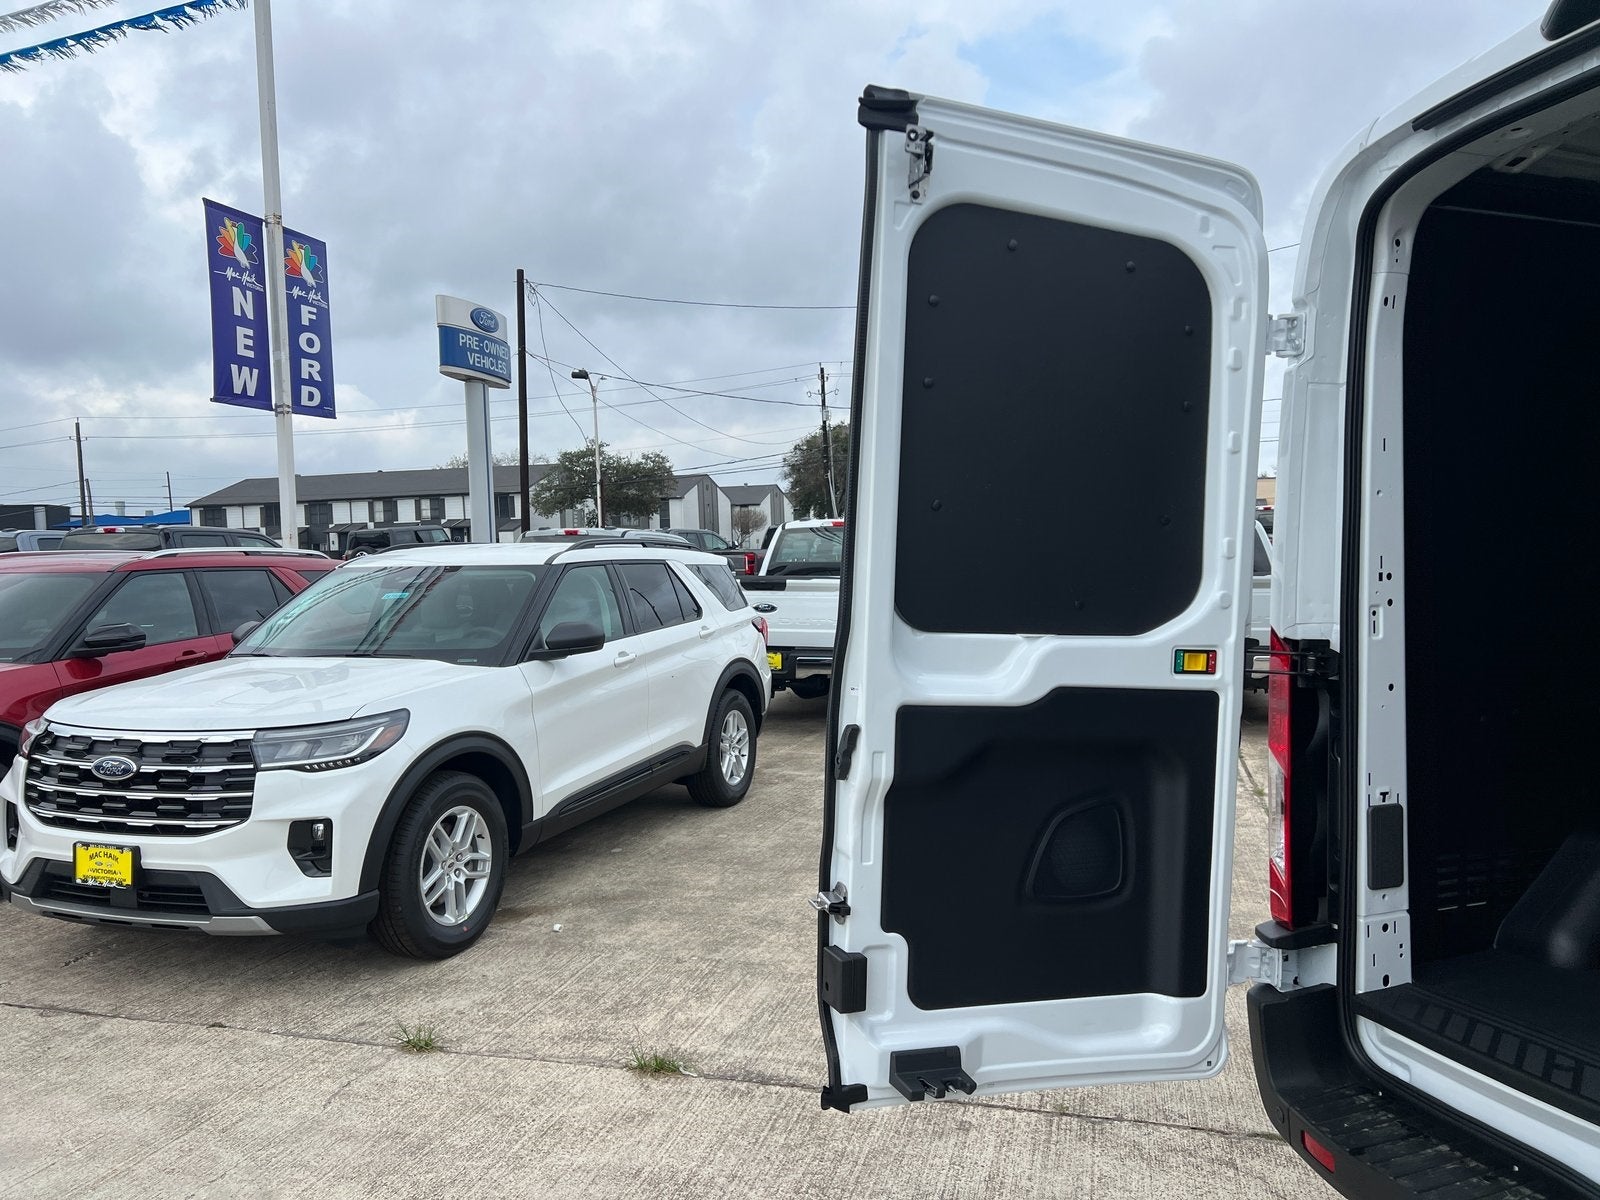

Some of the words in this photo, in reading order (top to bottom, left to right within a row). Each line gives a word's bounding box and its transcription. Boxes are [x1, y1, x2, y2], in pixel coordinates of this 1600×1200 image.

[479, 311, 495, 328] Ford
[230, 286, 259, 397] NEW
[459, 333, 509, 360] PRE-OWNED
[298, 304, 322, 407] FORD
[467, 352, 507, 375] VEHICLES
[100, 760, 126, 775] Ford
[89, 851, 102, 861] MAC
